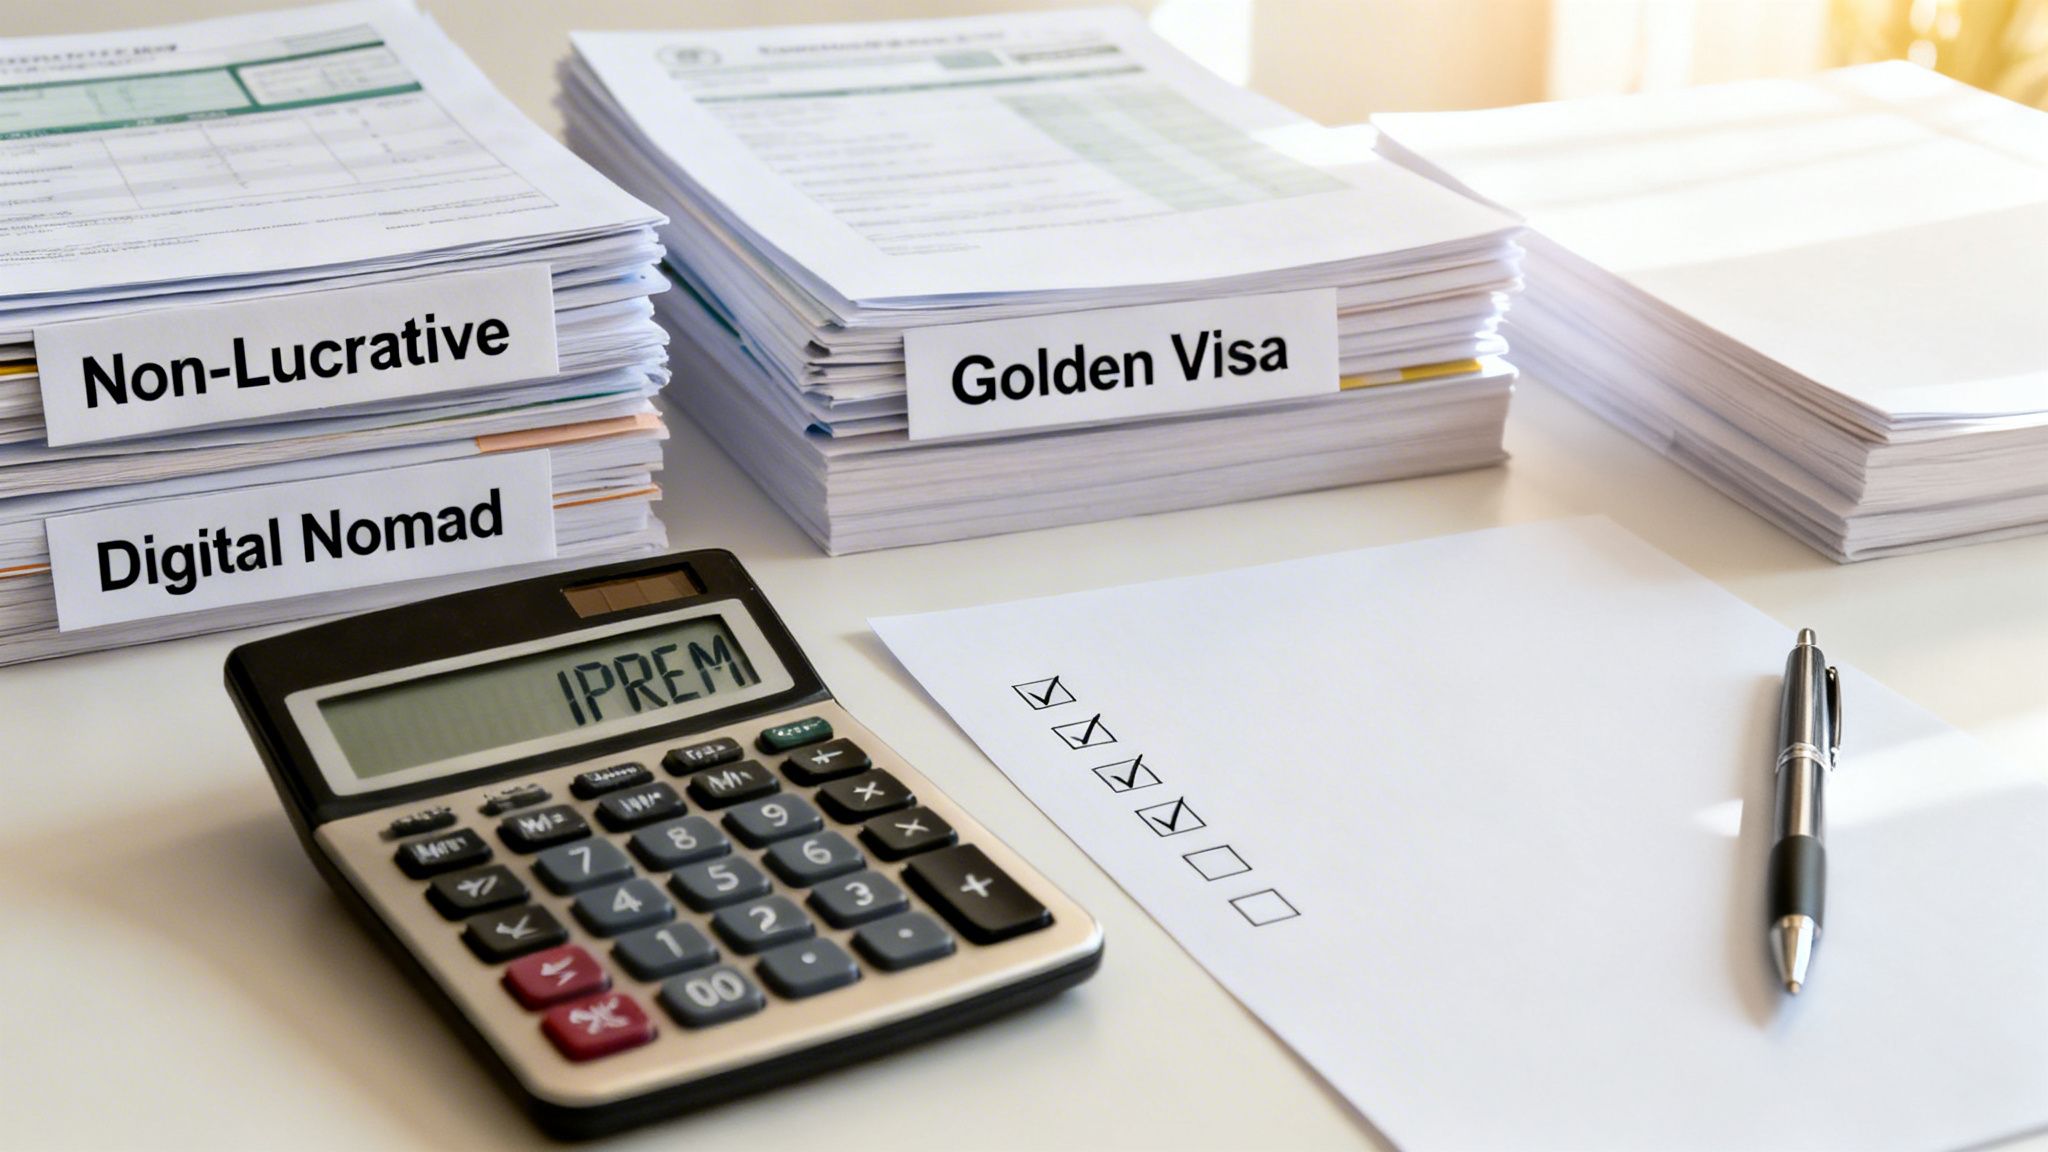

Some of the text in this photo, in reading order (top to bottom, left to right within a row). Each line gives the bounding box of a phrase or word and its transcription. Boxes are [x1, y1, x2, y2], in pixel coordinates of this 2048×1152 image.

[82, 312, 510, 409] Non-Lucrative
[951, 329, 1289, 406] Golden Visa
[96, 487, 503, 596] Digital Nomad
[556, 634, 747, 727] IPREM
[760, 803, 788, 827] 9
[666, 827, 697, 850] 8
[802, 840, 832, 865] 6
[568, 846, 592, 874] 7
[707, 864, 739, 892] 5
[612, 888, 643, 913] 4
[845, 881, 874, 906] 3
[749, 905, 779, 934] 2
[656, 930, 683, 958] 1
[685, 971, 746, 1007] 00
